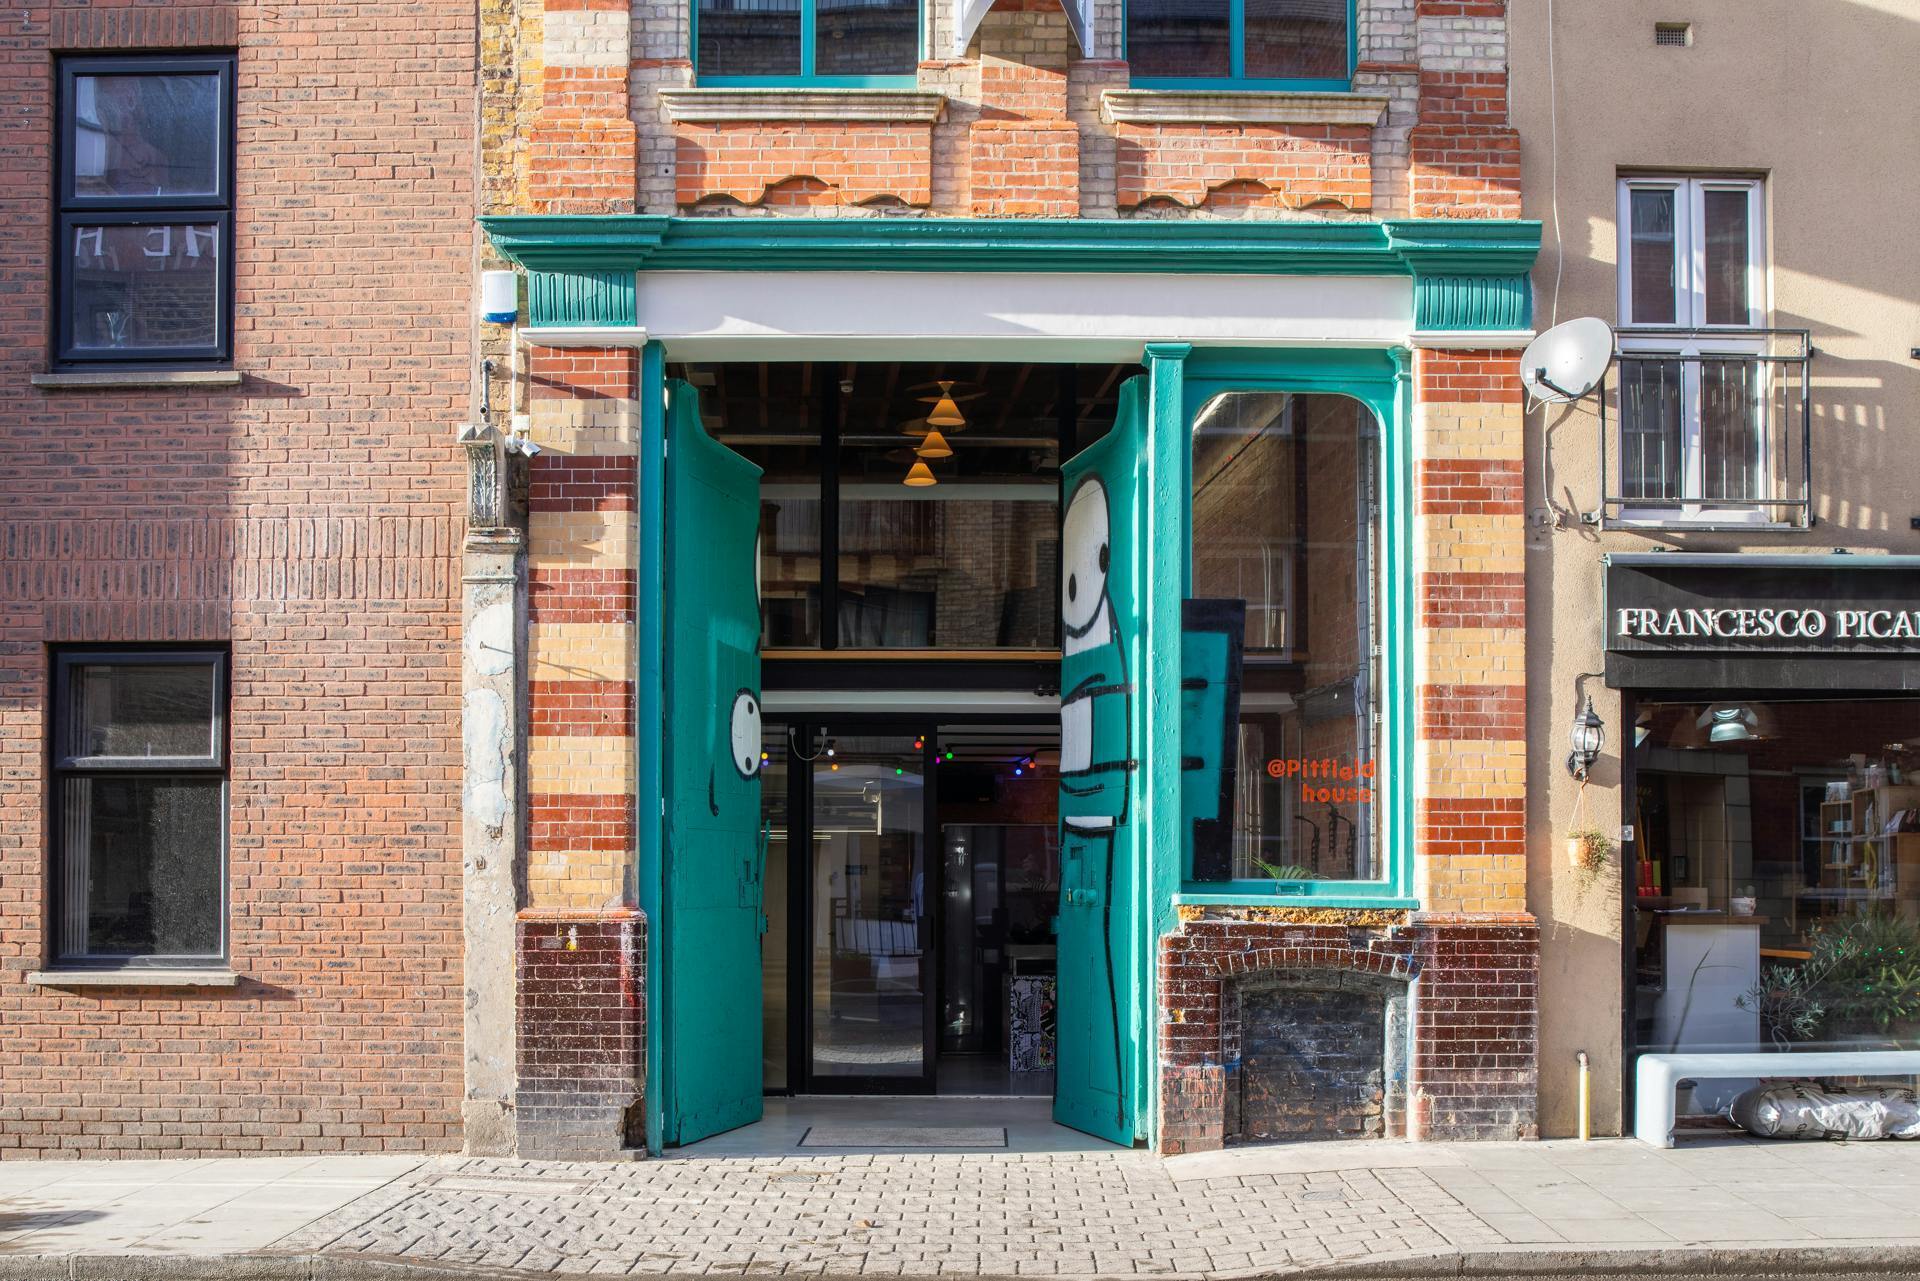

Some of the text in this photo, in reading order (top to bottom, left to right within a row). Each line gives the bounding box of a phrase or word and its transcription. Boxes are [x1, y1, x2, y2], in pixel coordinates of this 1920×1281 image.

[1616, 608, 1920, 638] FRANCESCO PICA
[1267, 758, 1375, 780] @Pitfield
[1302, 783, 1372, 803] house
